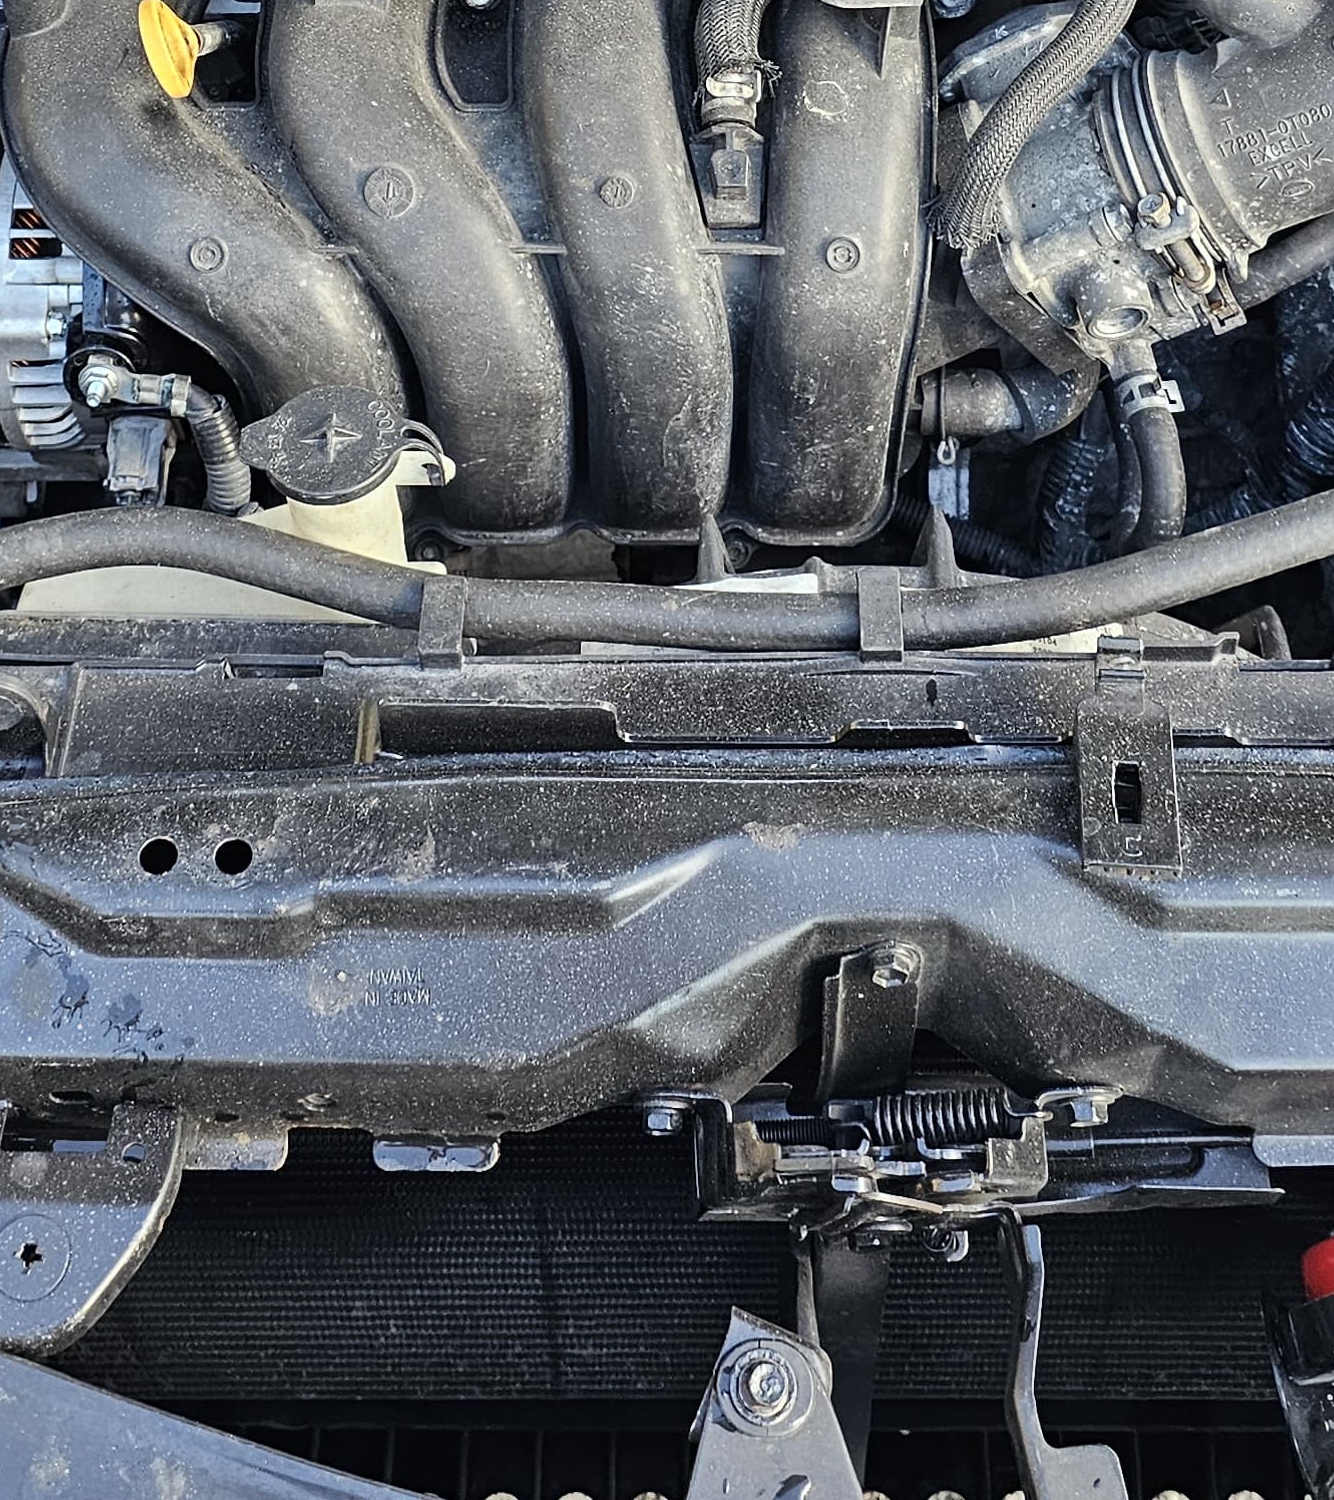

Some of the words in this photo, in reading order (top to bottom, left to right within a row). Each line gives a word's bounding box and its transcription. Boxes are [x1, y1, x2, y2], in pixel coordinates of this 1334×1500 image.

[1218, 103, 1332, 158] 17881-0T080
[1248, 131, 1313, 166] EXCELL
[366, 966, 424, 985] TAIWAN
[363, 988, 380, 1005] IN
[385, 987, 431, 1006] MADE
